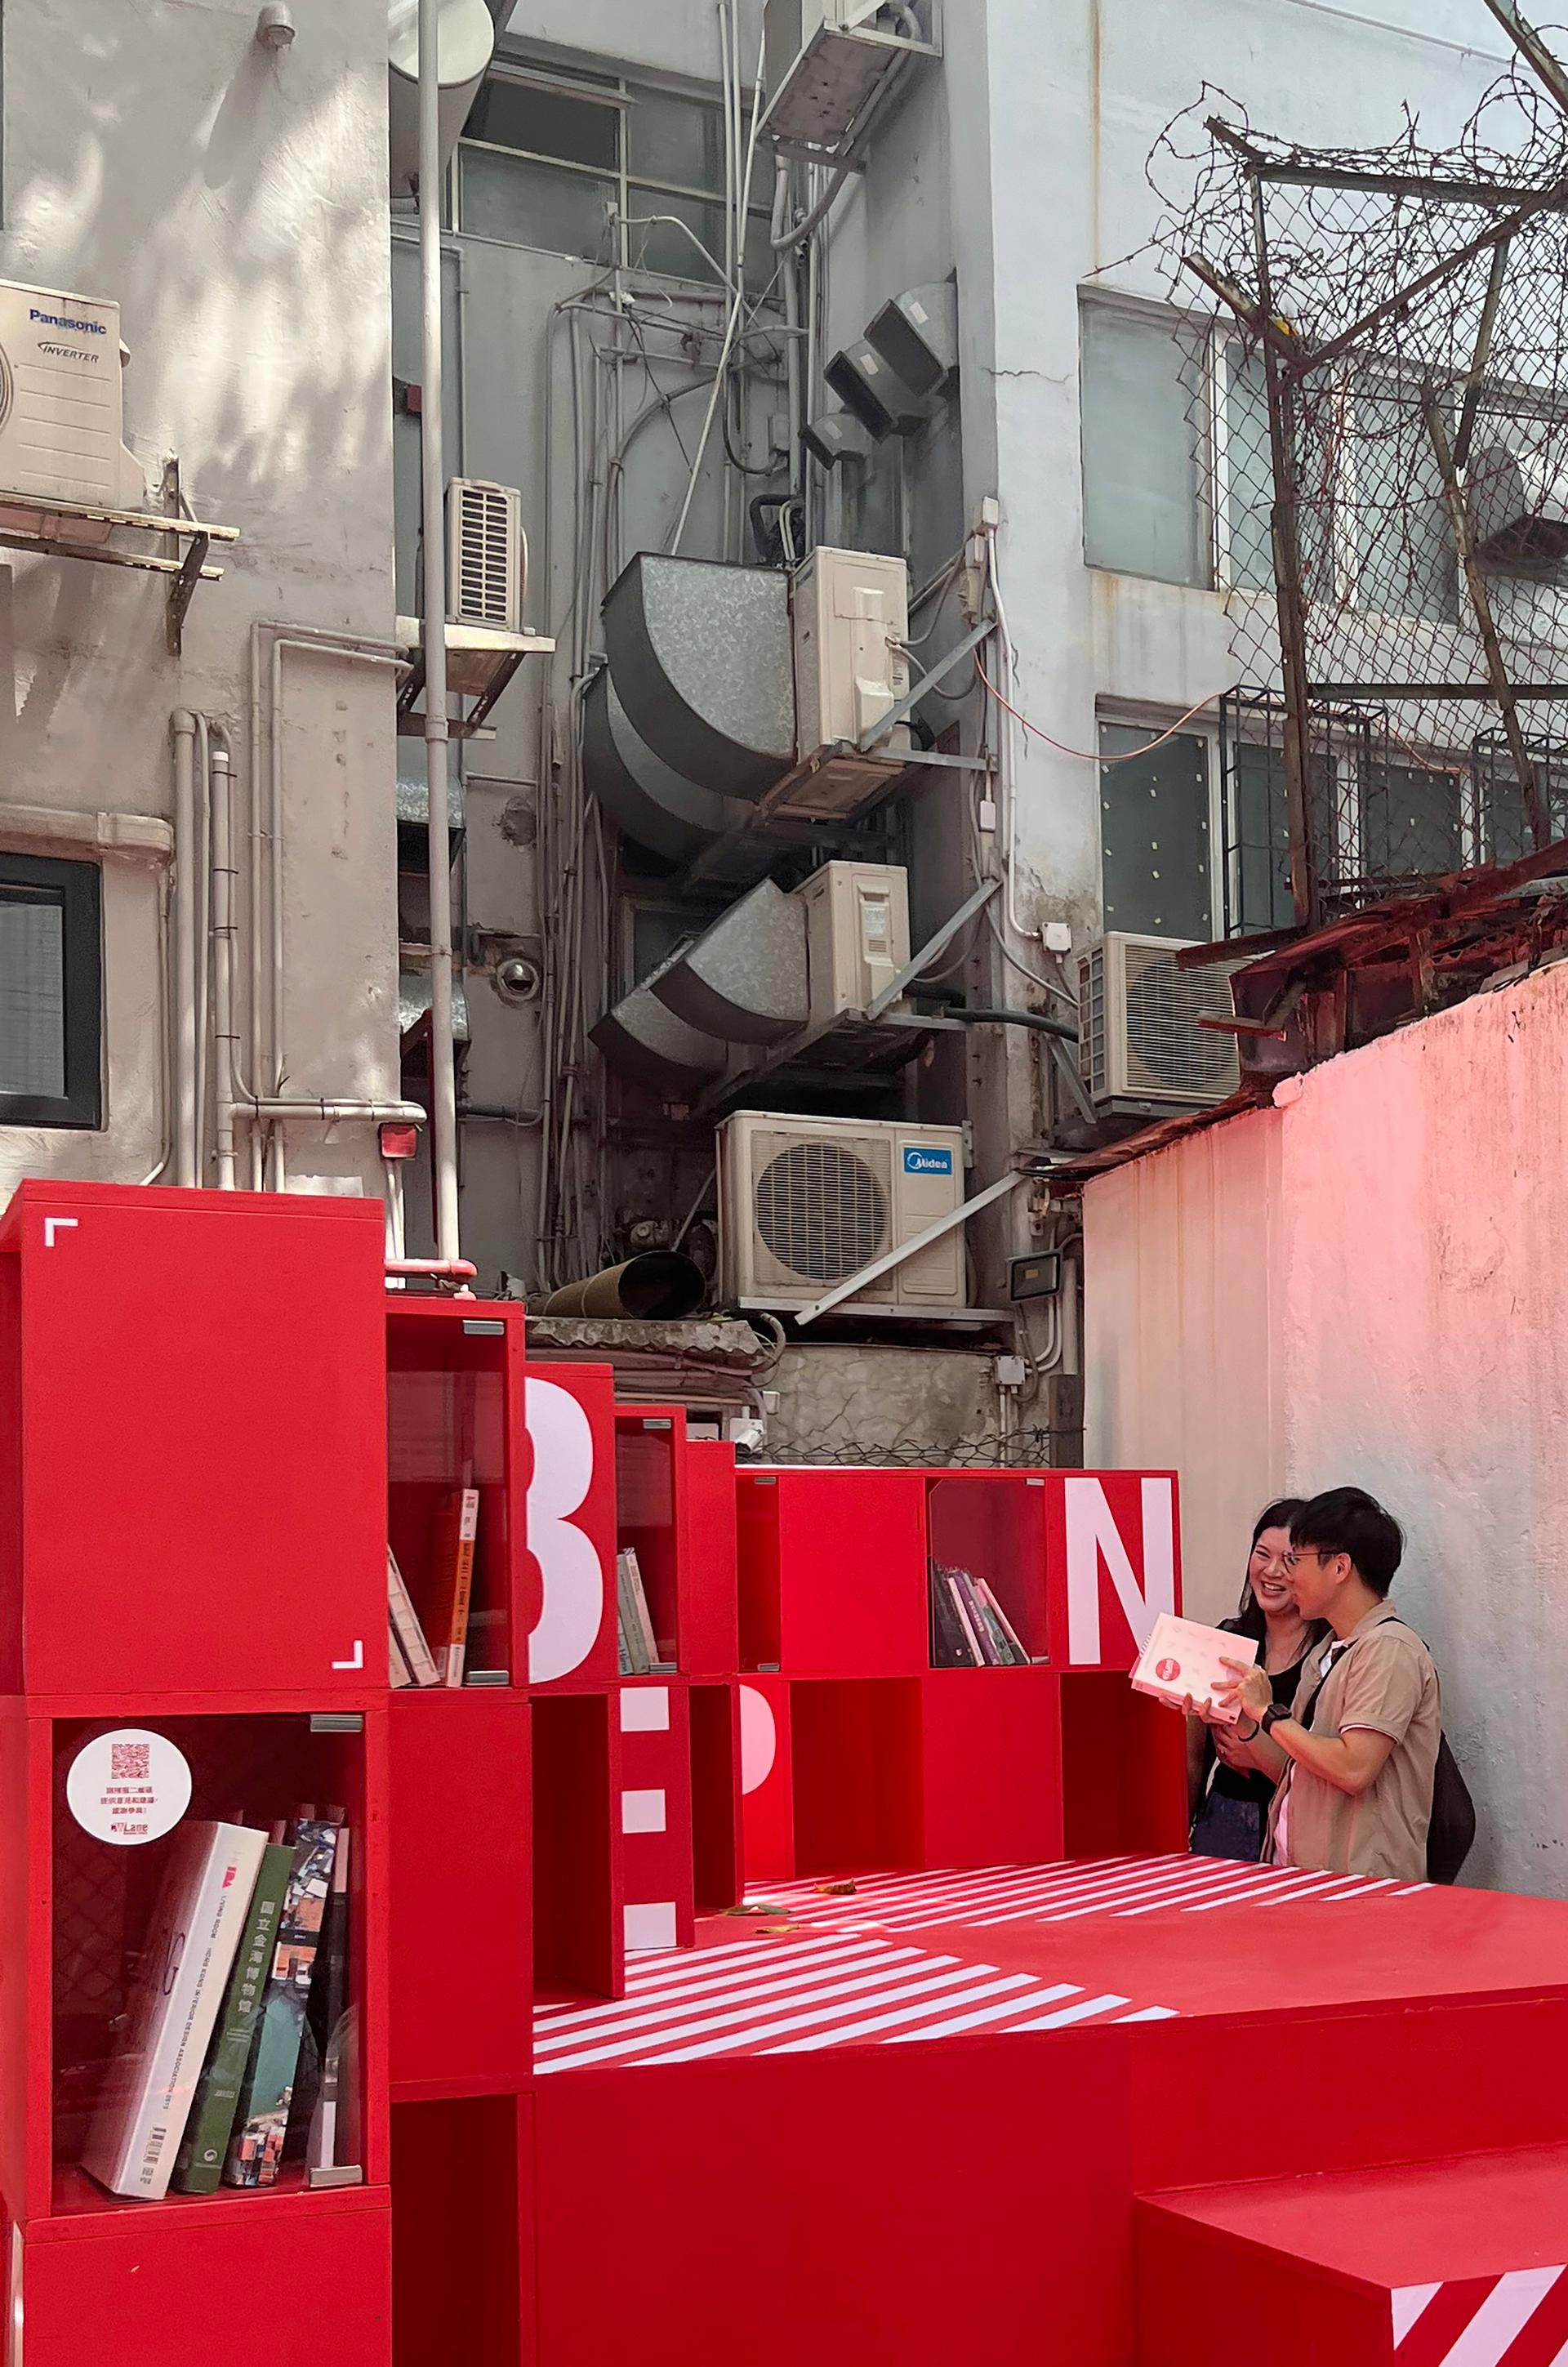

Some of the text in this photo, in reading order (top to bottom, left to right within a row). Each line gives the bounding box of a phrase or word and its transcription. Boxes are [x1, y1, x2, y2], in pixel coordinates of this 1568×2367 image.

[29, 309, 106, 334] Panasonic
[43, 344, 100, 363] INVERTER
[907, 1152, 947, 1170] Midea
[1064, 1478, 1175, 1665] N
